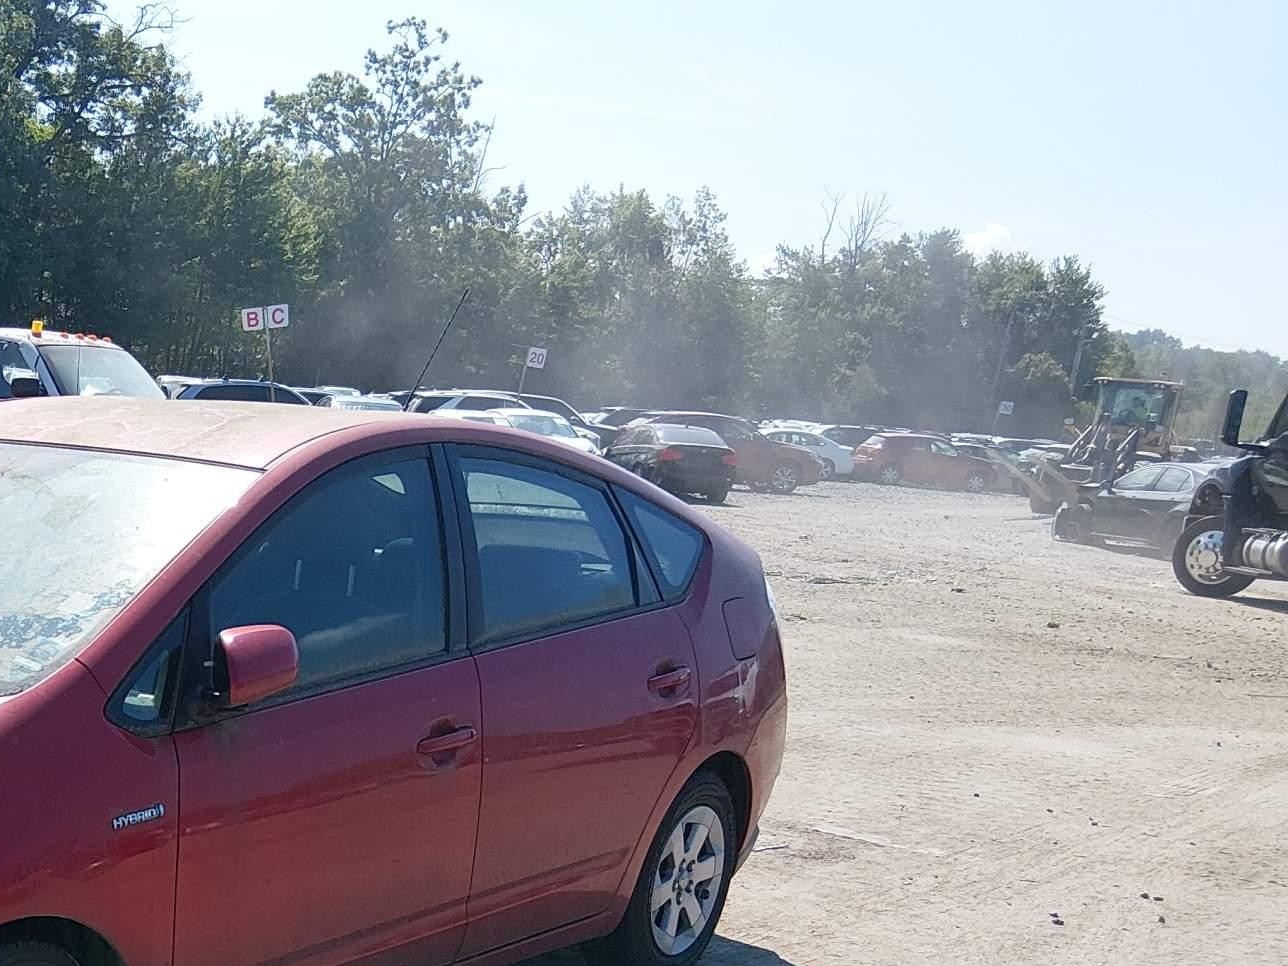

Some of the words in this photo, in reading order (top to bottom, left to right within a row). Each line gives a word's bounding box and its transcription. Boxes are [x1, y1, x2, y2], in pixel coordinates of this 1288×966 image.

[247, 312, 259, 327] B
[272, 308, 284, 324] C
[529, 352, 544, 364] 20
[113, 807, 158, 830] HYBRID
